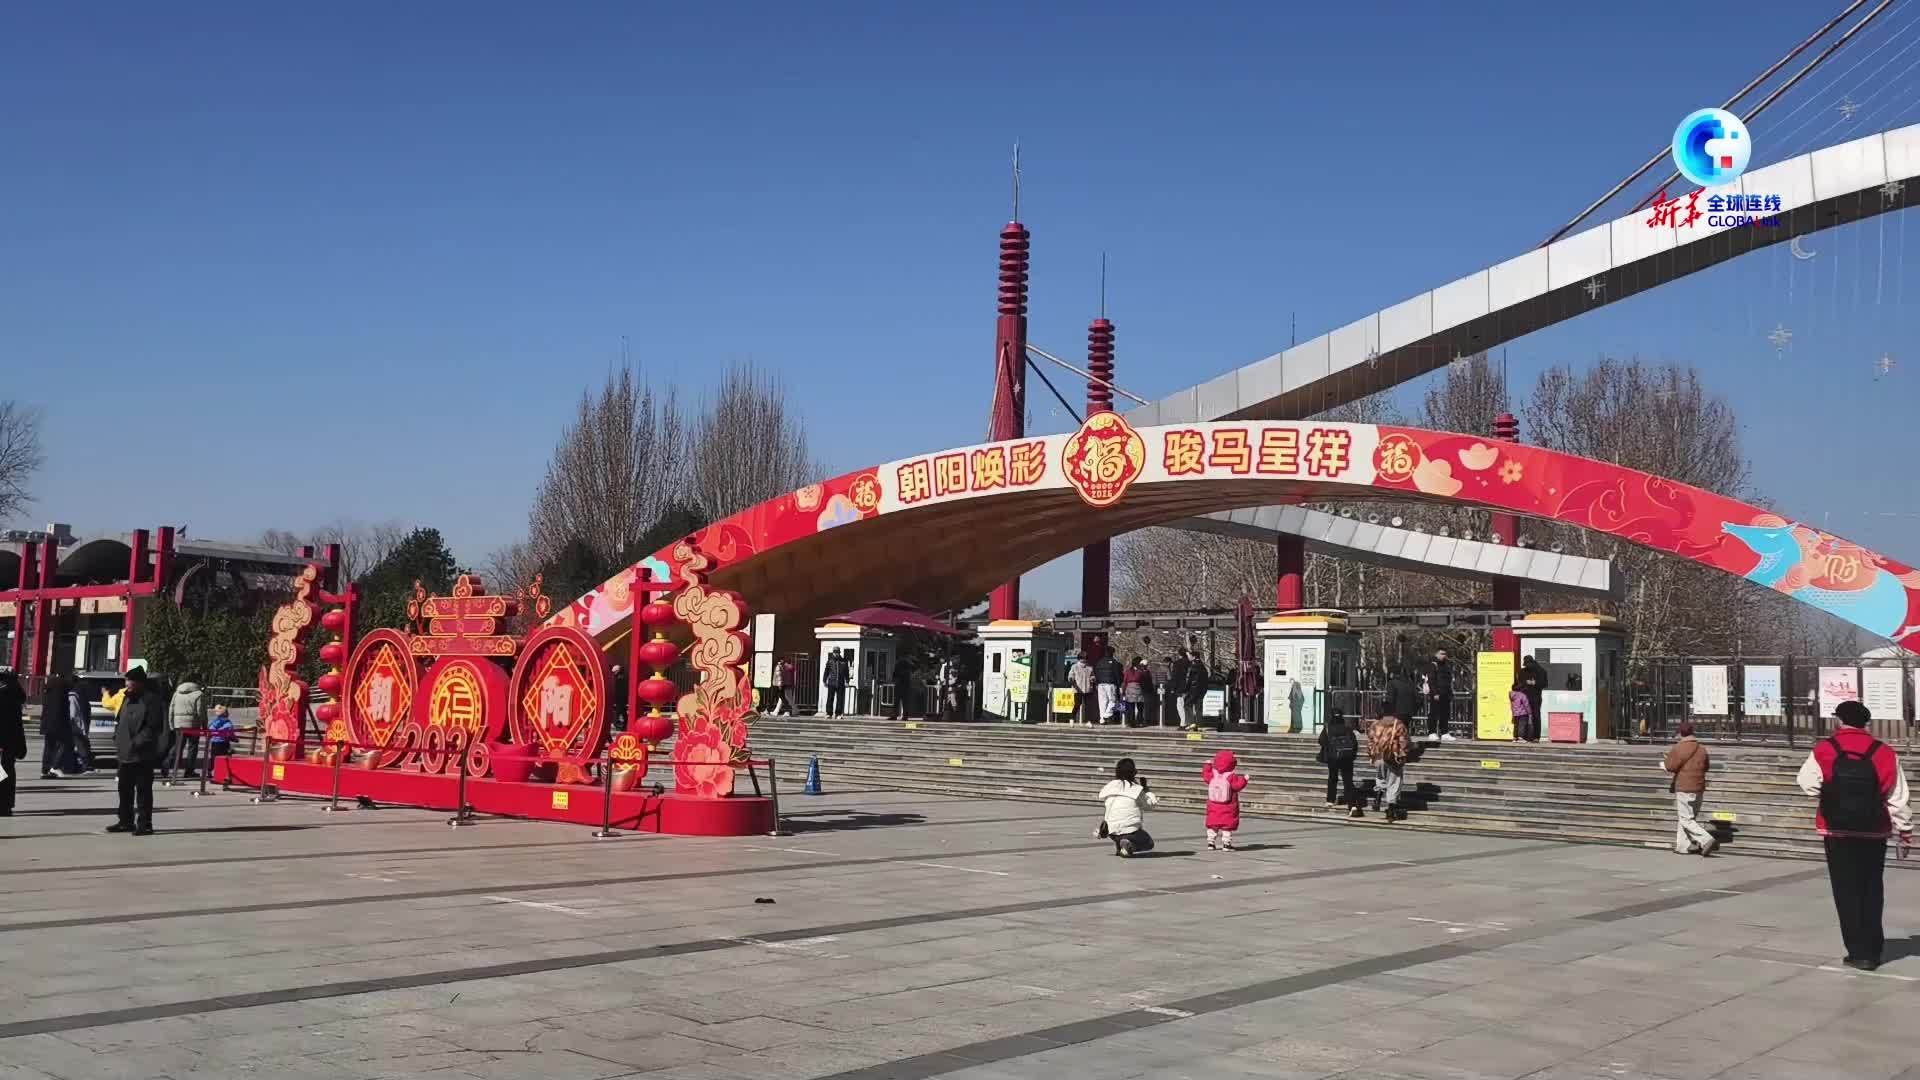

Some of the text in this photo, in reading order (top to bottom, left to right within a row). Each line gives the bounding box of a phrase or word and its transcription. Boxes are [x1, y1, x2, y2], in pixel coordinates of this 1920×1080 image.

[897, 441, 1047, 503] 朝阳焕彩
[1163, 429, 1352, 477] 骏马呈祥
[400, 721, 492, 778] 2026
